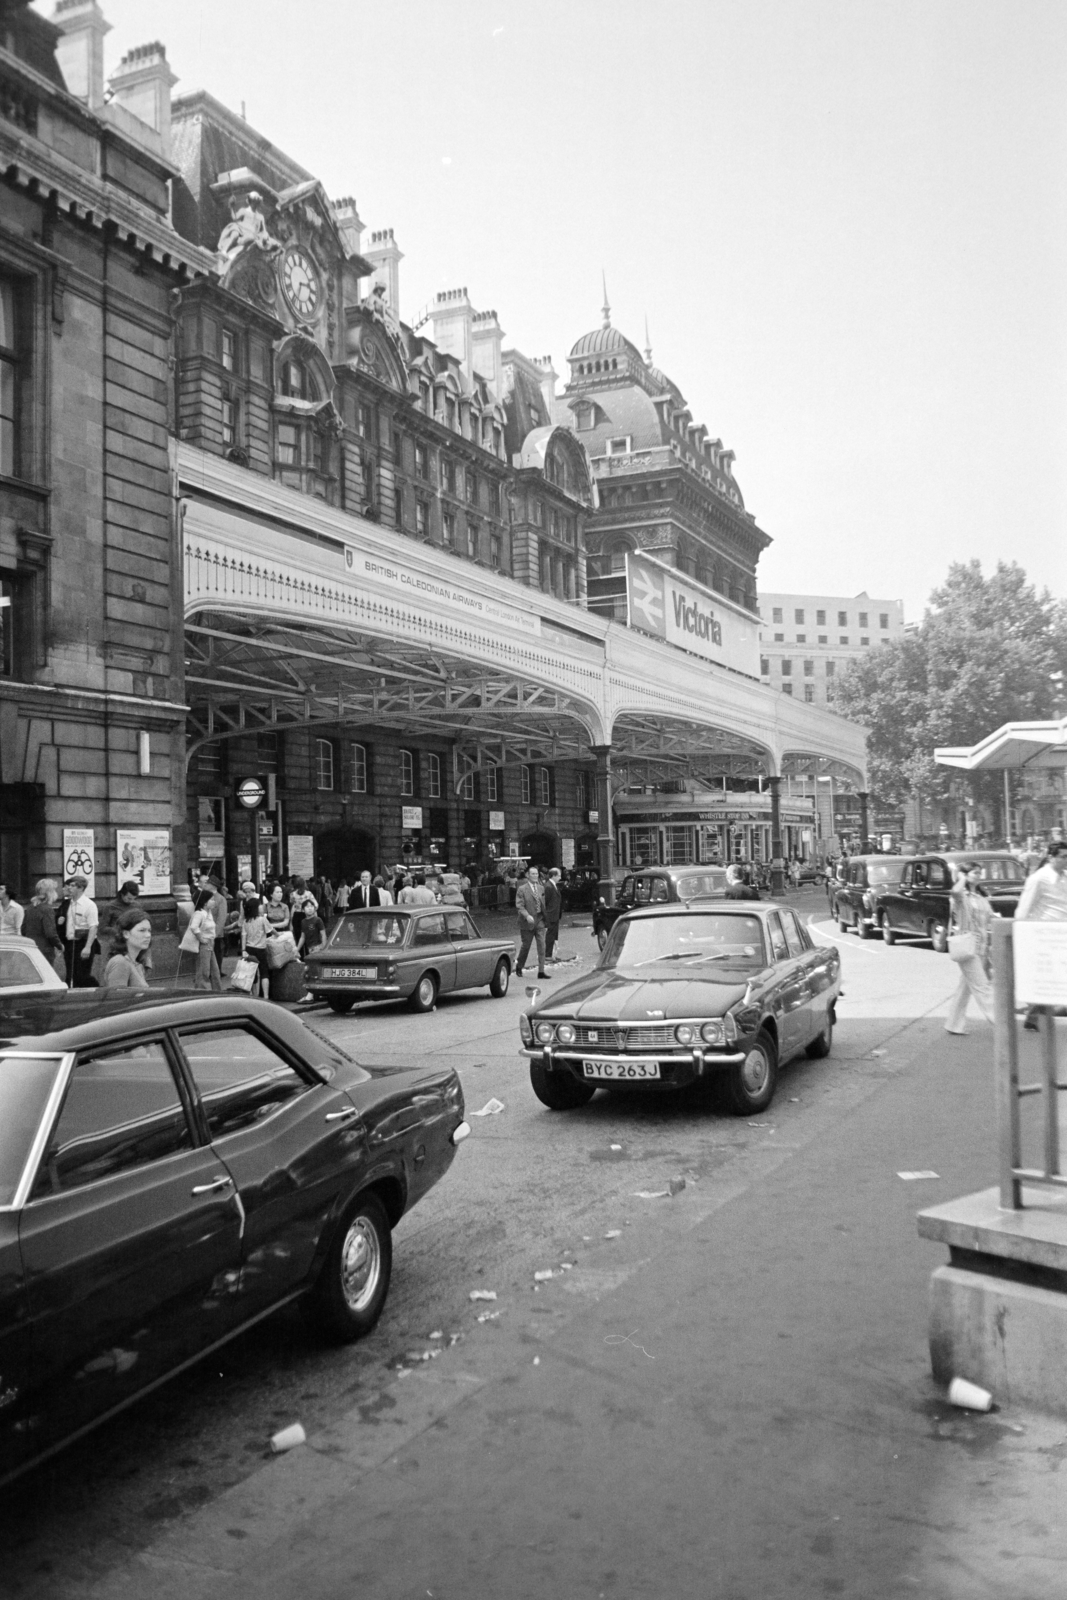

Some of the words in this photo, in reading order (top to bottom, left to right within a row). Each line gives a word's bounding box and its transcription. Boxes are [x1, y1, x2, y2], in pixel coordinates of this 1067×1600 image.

[364, 560, 398, 581] BRITISH
[400, 574, 451, 600] CALEDONIAN
[452, 591, 483, 611] AIRWAYS
[672, 590, 722, 647] Victoria
[236, 789, 266, 797] UNDERGROUND
[699, 812, 726, 820] WHISTLE
[331, 969, 346, 977] HJG
[347, 969, 366, 977] 384L
[585, 1063, 613, 1077] BYC
[617, 1064, 658, 1077] 263J
